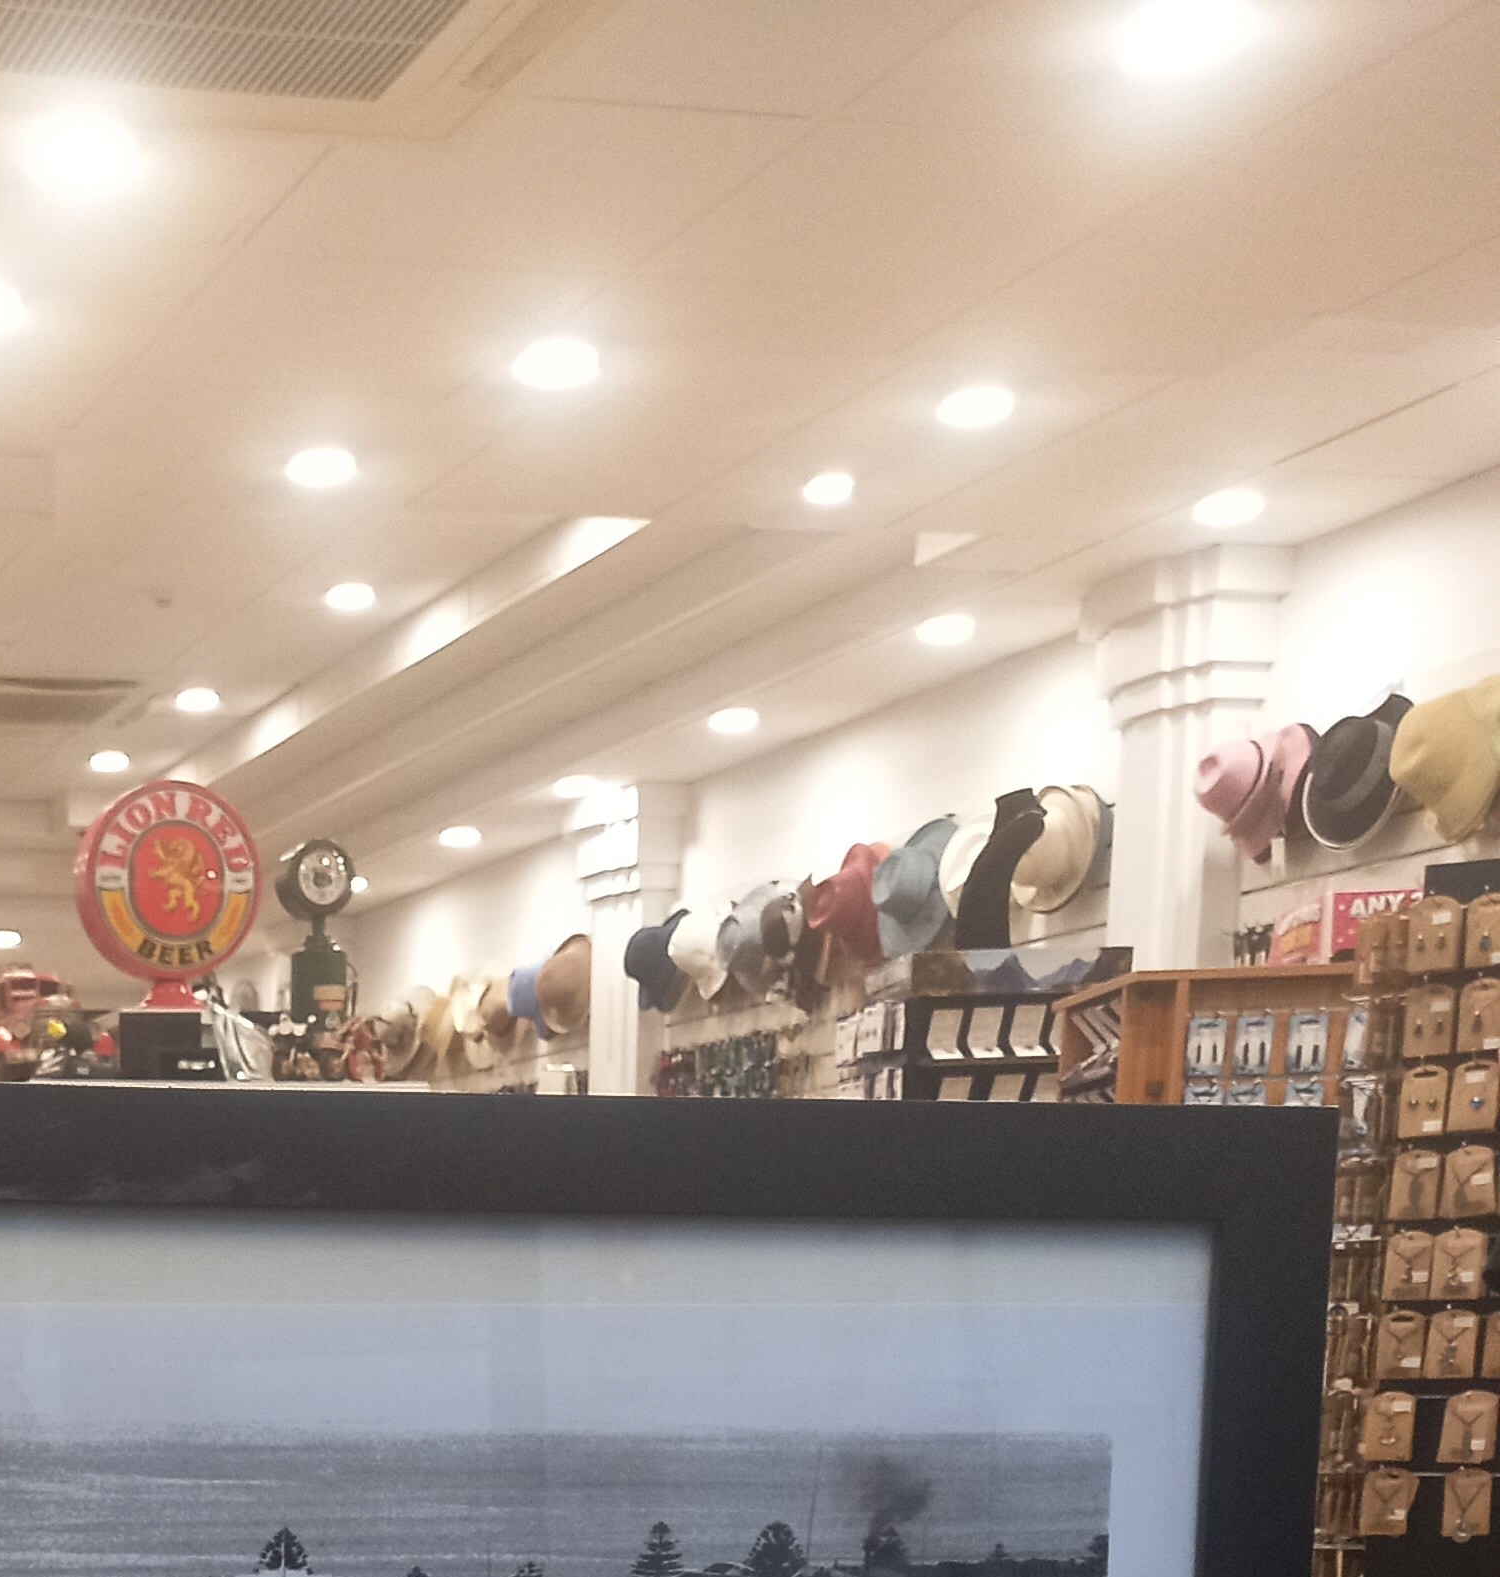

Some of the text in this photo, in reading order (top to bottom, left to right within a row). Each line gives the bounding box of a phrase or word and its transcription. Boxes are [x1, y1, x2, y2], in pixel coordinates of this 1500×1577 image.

[99, 790, 250, 873] LION RED
[1349, 893, 1405, 919] ANY
[137, 938, 214, 966] BEER
